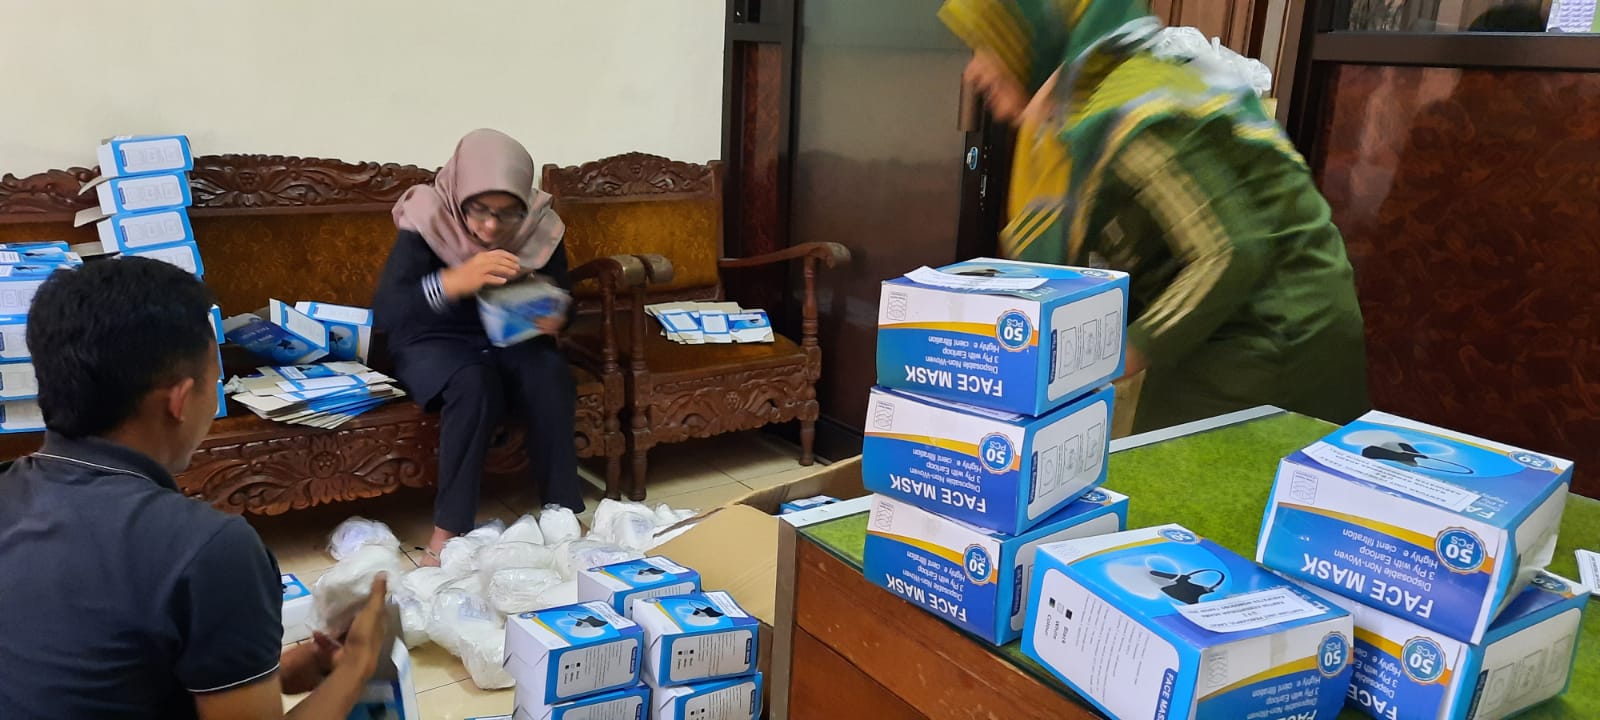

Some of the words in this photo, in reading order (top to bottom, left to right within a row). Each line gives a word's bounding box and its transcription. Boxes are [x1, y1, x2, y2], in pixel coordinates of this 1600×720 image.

[1006, 319, 1023, 327] PCS
[928, 336, 952, 345] filtration
[1004, 327, 1023, 341] 50
[943, 348, 966, 359] Earloop
[980, 342, 999, 353] Highly
[925, 356, 961, 368] Non-Woven
[968, 352, 981, 360] with
[983, 353, 993, 362] Ply
[962, 361, 998, 374] Disposable
[904, 365, 952, 388] MASK
[957, 373, 1003, 397] FACE
[990, 441, 1006, 451] PCS
[913, 449, 936, 462] filtration
[986, 448, 1006, 464] 50
[926, 462, 950, 475] Earloop
[963, 461, 982, 474] Highly
[909, 467, 944, 483] Non-Woven
[951, 470, 963, 479] with
[965, 472, 975, 482] Ply
[889, 473, 936, 500] MASK
[946, 478, 980, 493] Disposable
[941, 487, 986, 513] FACE
[1342, 528, 1375, 547] filtration
[1450, 535, 1474, 550] PCS
[1376, 540, 1397, 553] cient
[906, 551, 927, 566] filtration
[972, 552, 986, 563] PCS
[1359, 545, 1392, 567] Earloop
[1410, 552, 1439, 569] Highly
[1445, 544, 1473, 564] 50
[969, 558, 986, 575] 50
[1334, 549, 1382, 574] Non-Woven
[1393, 560, 1411, 572] with
[918, 565, 938, 580] Earloop
[949, 567, 966, 582] Highly
[1301, 553, 1366, 593] MASK
[1412, 565, 1427, 578] Ply
[1428, 571, 1435, 580] 3
[938, 575, 950, 585] with
[950, 579, 959, 590] Ply
[1382, 568, 1432, 592] Disposable
[886, 573, 926, 604] MASK
[933, 583, 963, 602] Disposable
[1370, 579, 1433, 618] FACE
[928, 592, 967, 623] FACE
[1326, 642, 1342, 651] PCS
[1416, 645, 1437, 661] PCS
[1324, 650, 1342, 666] 50
[1409, 653, 1434, 675] 50
[1363, 664, 1378, 676] with
[1379, 658, 1402, 678] Highly
[1302, 675, 1321, 686] Highly
[1379, 670, 1392, 685] Ply
[1392, 679, 1399, 688] 3
[1162, 672, 1174, 699] FACE
[1252, 686, 1277, 697] filtration
[1315, 687, 1320, 696] 3
[1291, 691, 1303, 700] with
[1304, 688, 1314, 697] Ply
[1266, 694, 1290, 705] Earloop
[1285, 698, 1317, 711] Disposable
[1346, 684, 1398, 720] FACE
